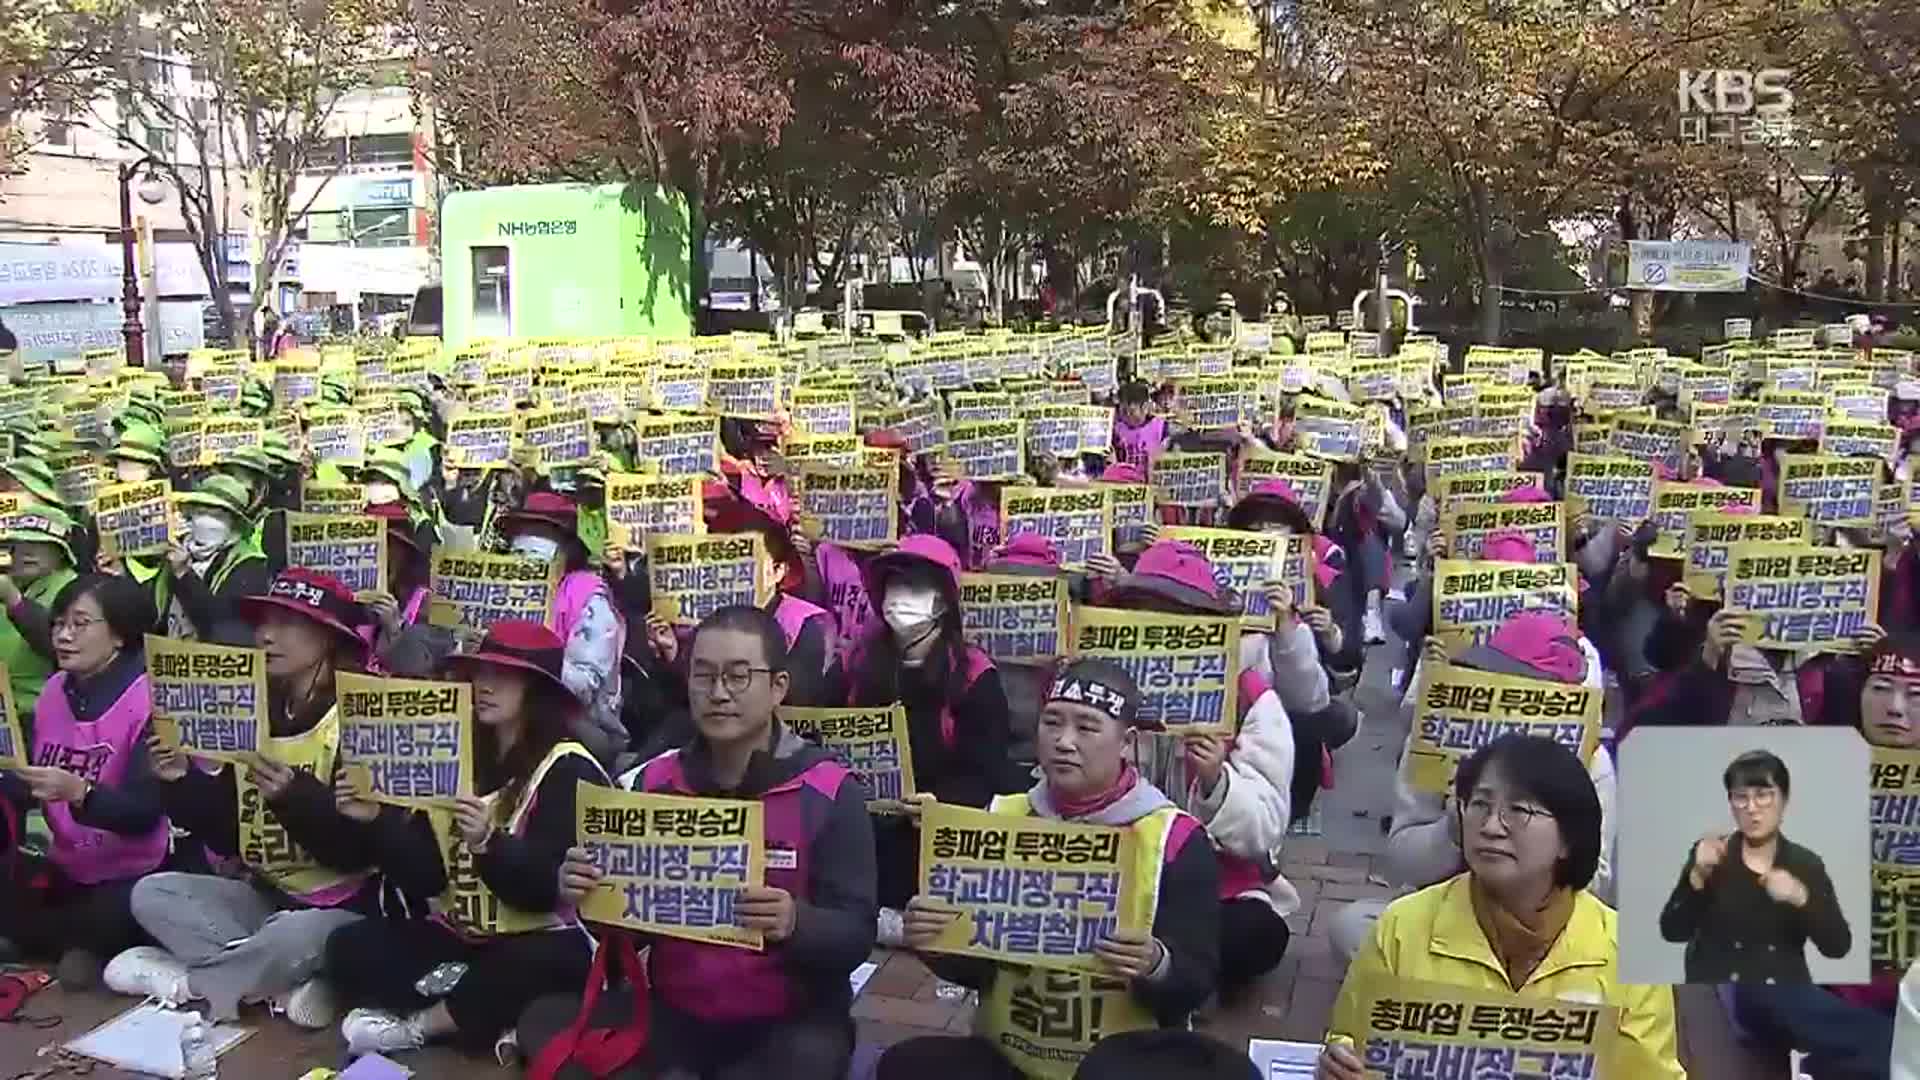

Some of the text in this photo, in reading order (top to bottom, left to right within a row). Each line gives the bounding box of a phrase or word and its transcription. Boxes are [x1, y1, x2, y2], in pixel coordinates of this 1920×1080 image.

[1695, 522, 1742, 542] 총파업
[1745, 520, 1803, 541] 투쟁승리
[654, 539, 754, 564] 총파업 투쟁승리
[1735, 556, 1793, 579] 총파업
[1796, 553, 1872, 577] 투쟁승리
[438, 559, 549, 581] 총파업 투쟁승리
[654, 563, 754, 592] 학교비정규직
[1442, 567, 1567, 595] 총파업 투쟁승리
[436, 579, 548, 607] 학교비정규직
[960, 584, 992, 603] 파업
[1732, 578, 1869, 611] 학교비정규직
[960, 605, 1057, 630] 교비정규직
[1079, 624, 1227, 651] 총파업 투쟁승리
[152, 653, 254, 678] 총파업 투쟁승리
[152, 682, 256, 714] 학교비정규직
[343, 687, 458, 717] 총파업 투쟁승리
[1084, 681, 1125, 716] 투쟁
[1427, 682, 1589, 717] 총파업 투쟁승리
[178, 717, 257, 752] 차별철폐
[342, 721, 460, 757] 학교비정규직
[820, 711, 893, 739] 투쟁승리
[369, 760, 460, 798] 차별철폐
[583, 806, 748, 838] 총파업 투쟁승리
[933, 826, 1121, 864] 총파업 투쟁승리
[928, 864, 1120, 911] 학교비정규직
[1371, 998, 1599, 1045] 총파업 투쟁승리
